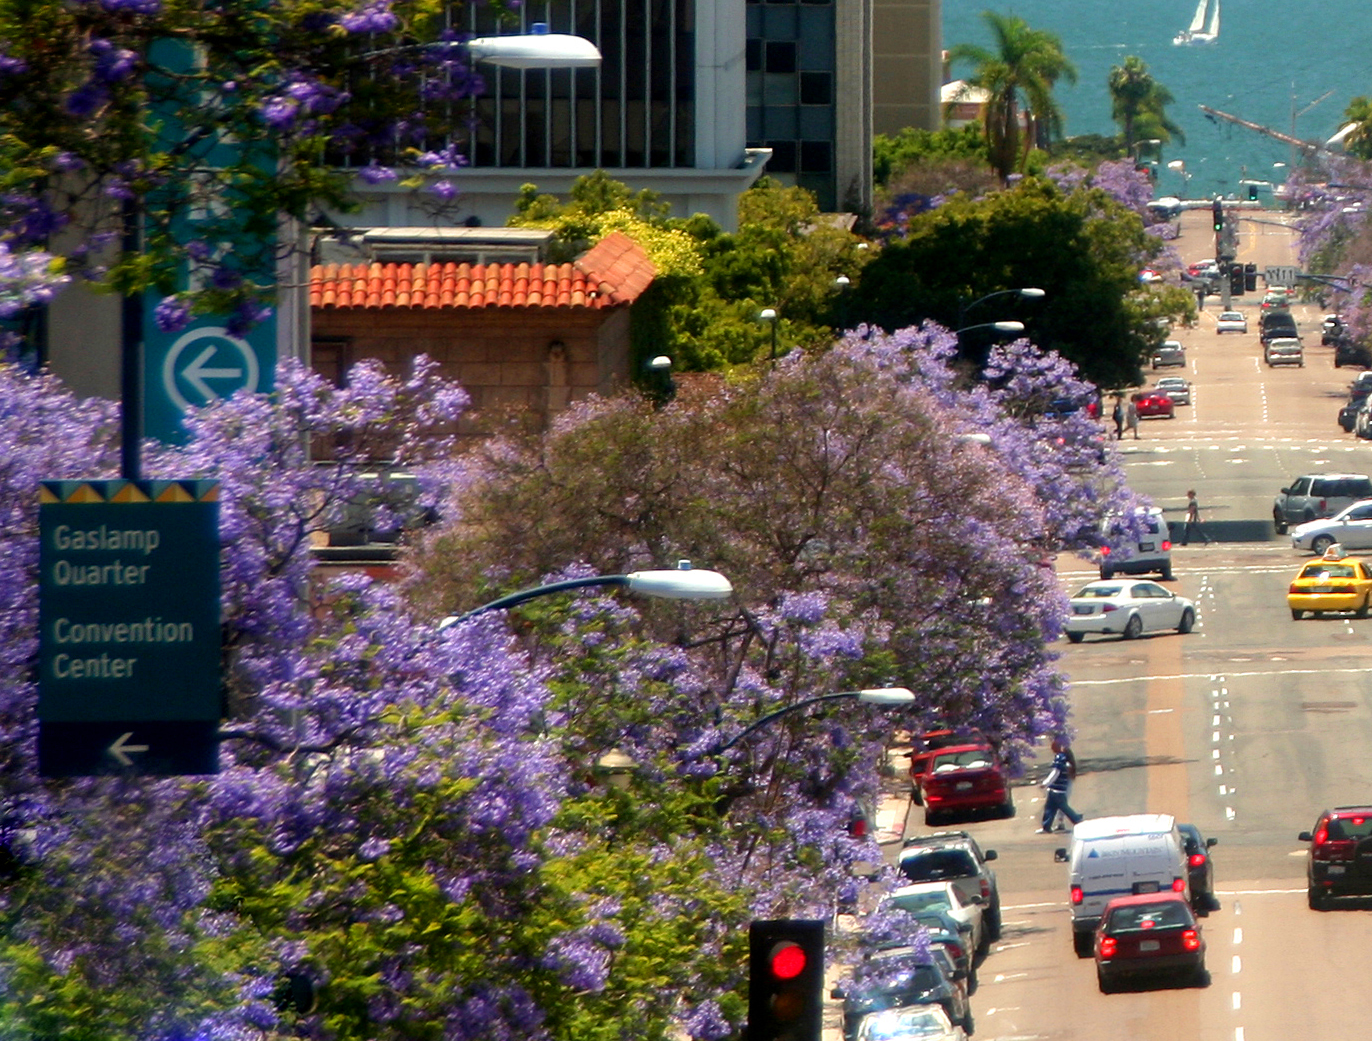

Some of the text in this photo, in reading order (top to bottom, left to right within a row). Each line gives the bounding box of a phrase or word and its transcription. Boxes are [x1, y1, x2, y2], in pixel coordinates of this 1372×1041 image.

[53, 524, 161, 556] Gaslamp
[53, 559, 151, 586] Quarter
[53, 616, 194, 644] Convention
[53, 652, 138, 679] Center
